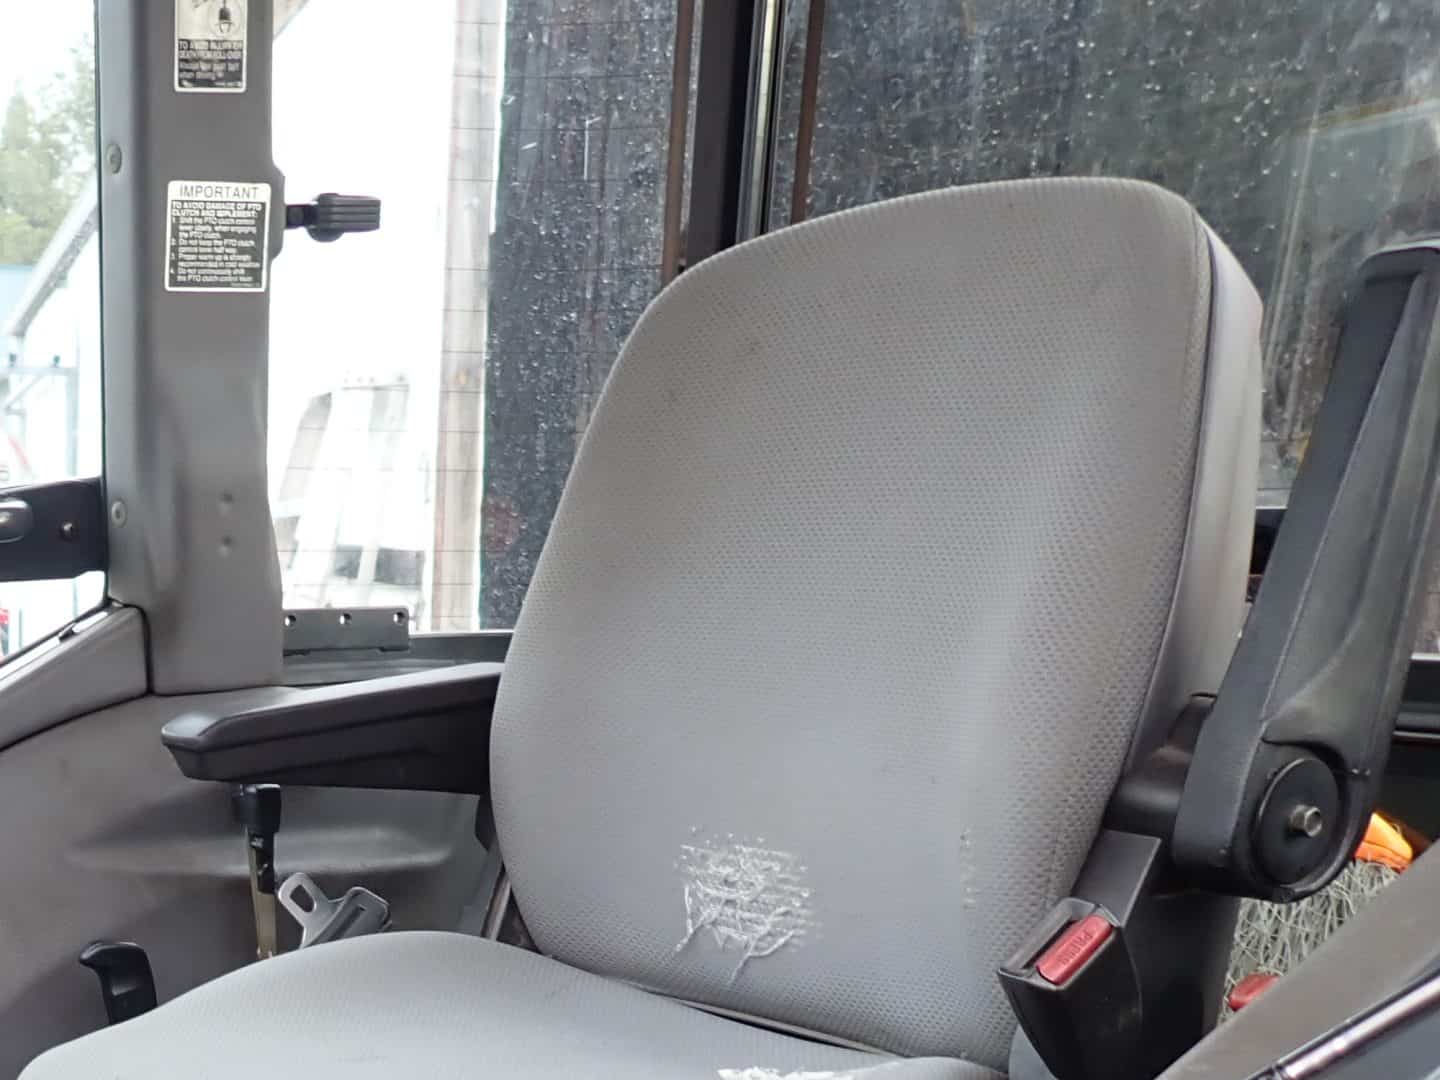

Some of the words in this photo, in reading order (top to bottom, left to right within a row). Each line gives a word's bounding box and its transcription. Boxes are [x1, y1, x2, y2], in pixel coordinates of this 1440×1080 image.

[180, 185, 259, 200] IMPORTANT
[247, 203, 262, 211] PTO
[172, 209, 200, 217] CLUTCH
